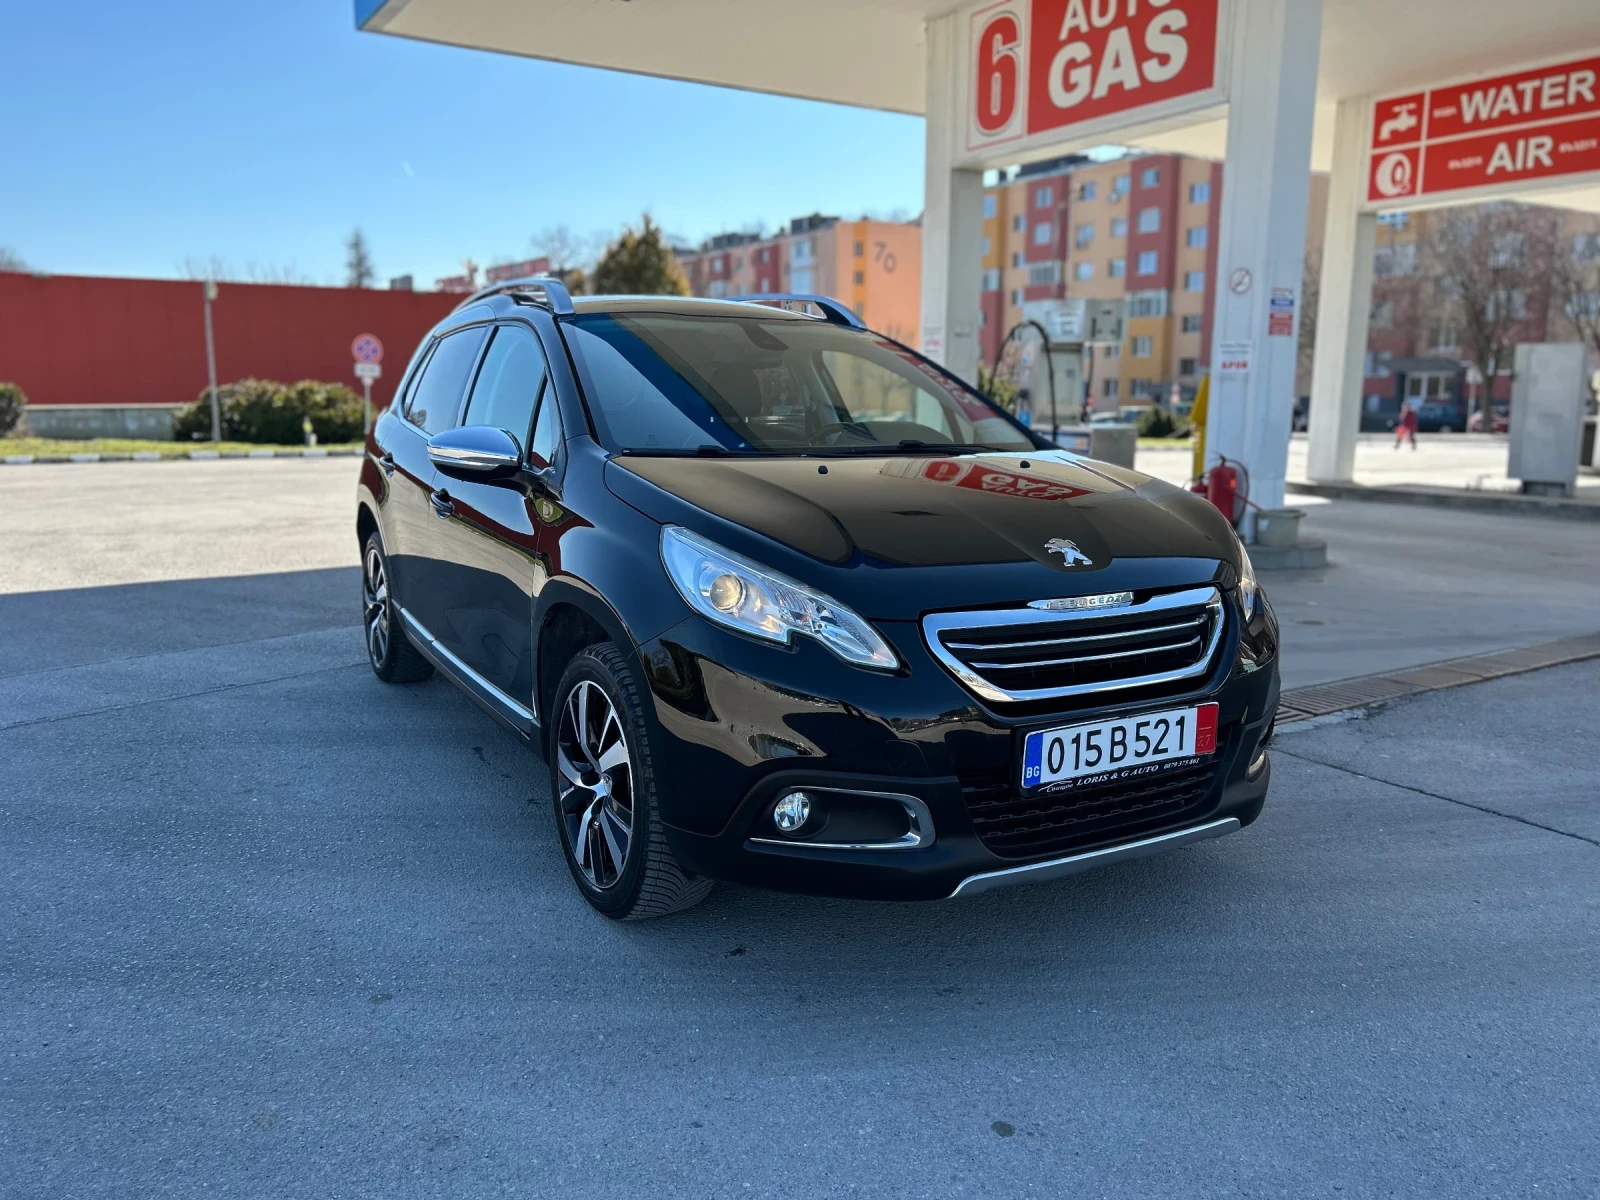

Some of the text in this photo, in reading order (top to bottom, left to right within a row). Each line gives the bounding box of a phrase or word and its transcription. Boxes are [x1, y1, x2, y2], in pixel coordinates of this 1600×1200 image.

[1059, 0, 1174, 41] AU
[974, 12, 1021, 136] 6
[1048, 8, 1189, 109] GAS
[1460, 69, 1597, 124] WATER
[1485, 135, 1554, 176] AIR
[873, 240, 898, 274] 70
[1047, 715, 1186, 775] 015B521
[1026, 766, 1040, 779] BG
[1076, 774, 1109, 786] LORIS
[1110, 771, 1119, 780] &
[1121, 770, 1130, 779] G
[1130, 764, 1159, 777] AUTO
